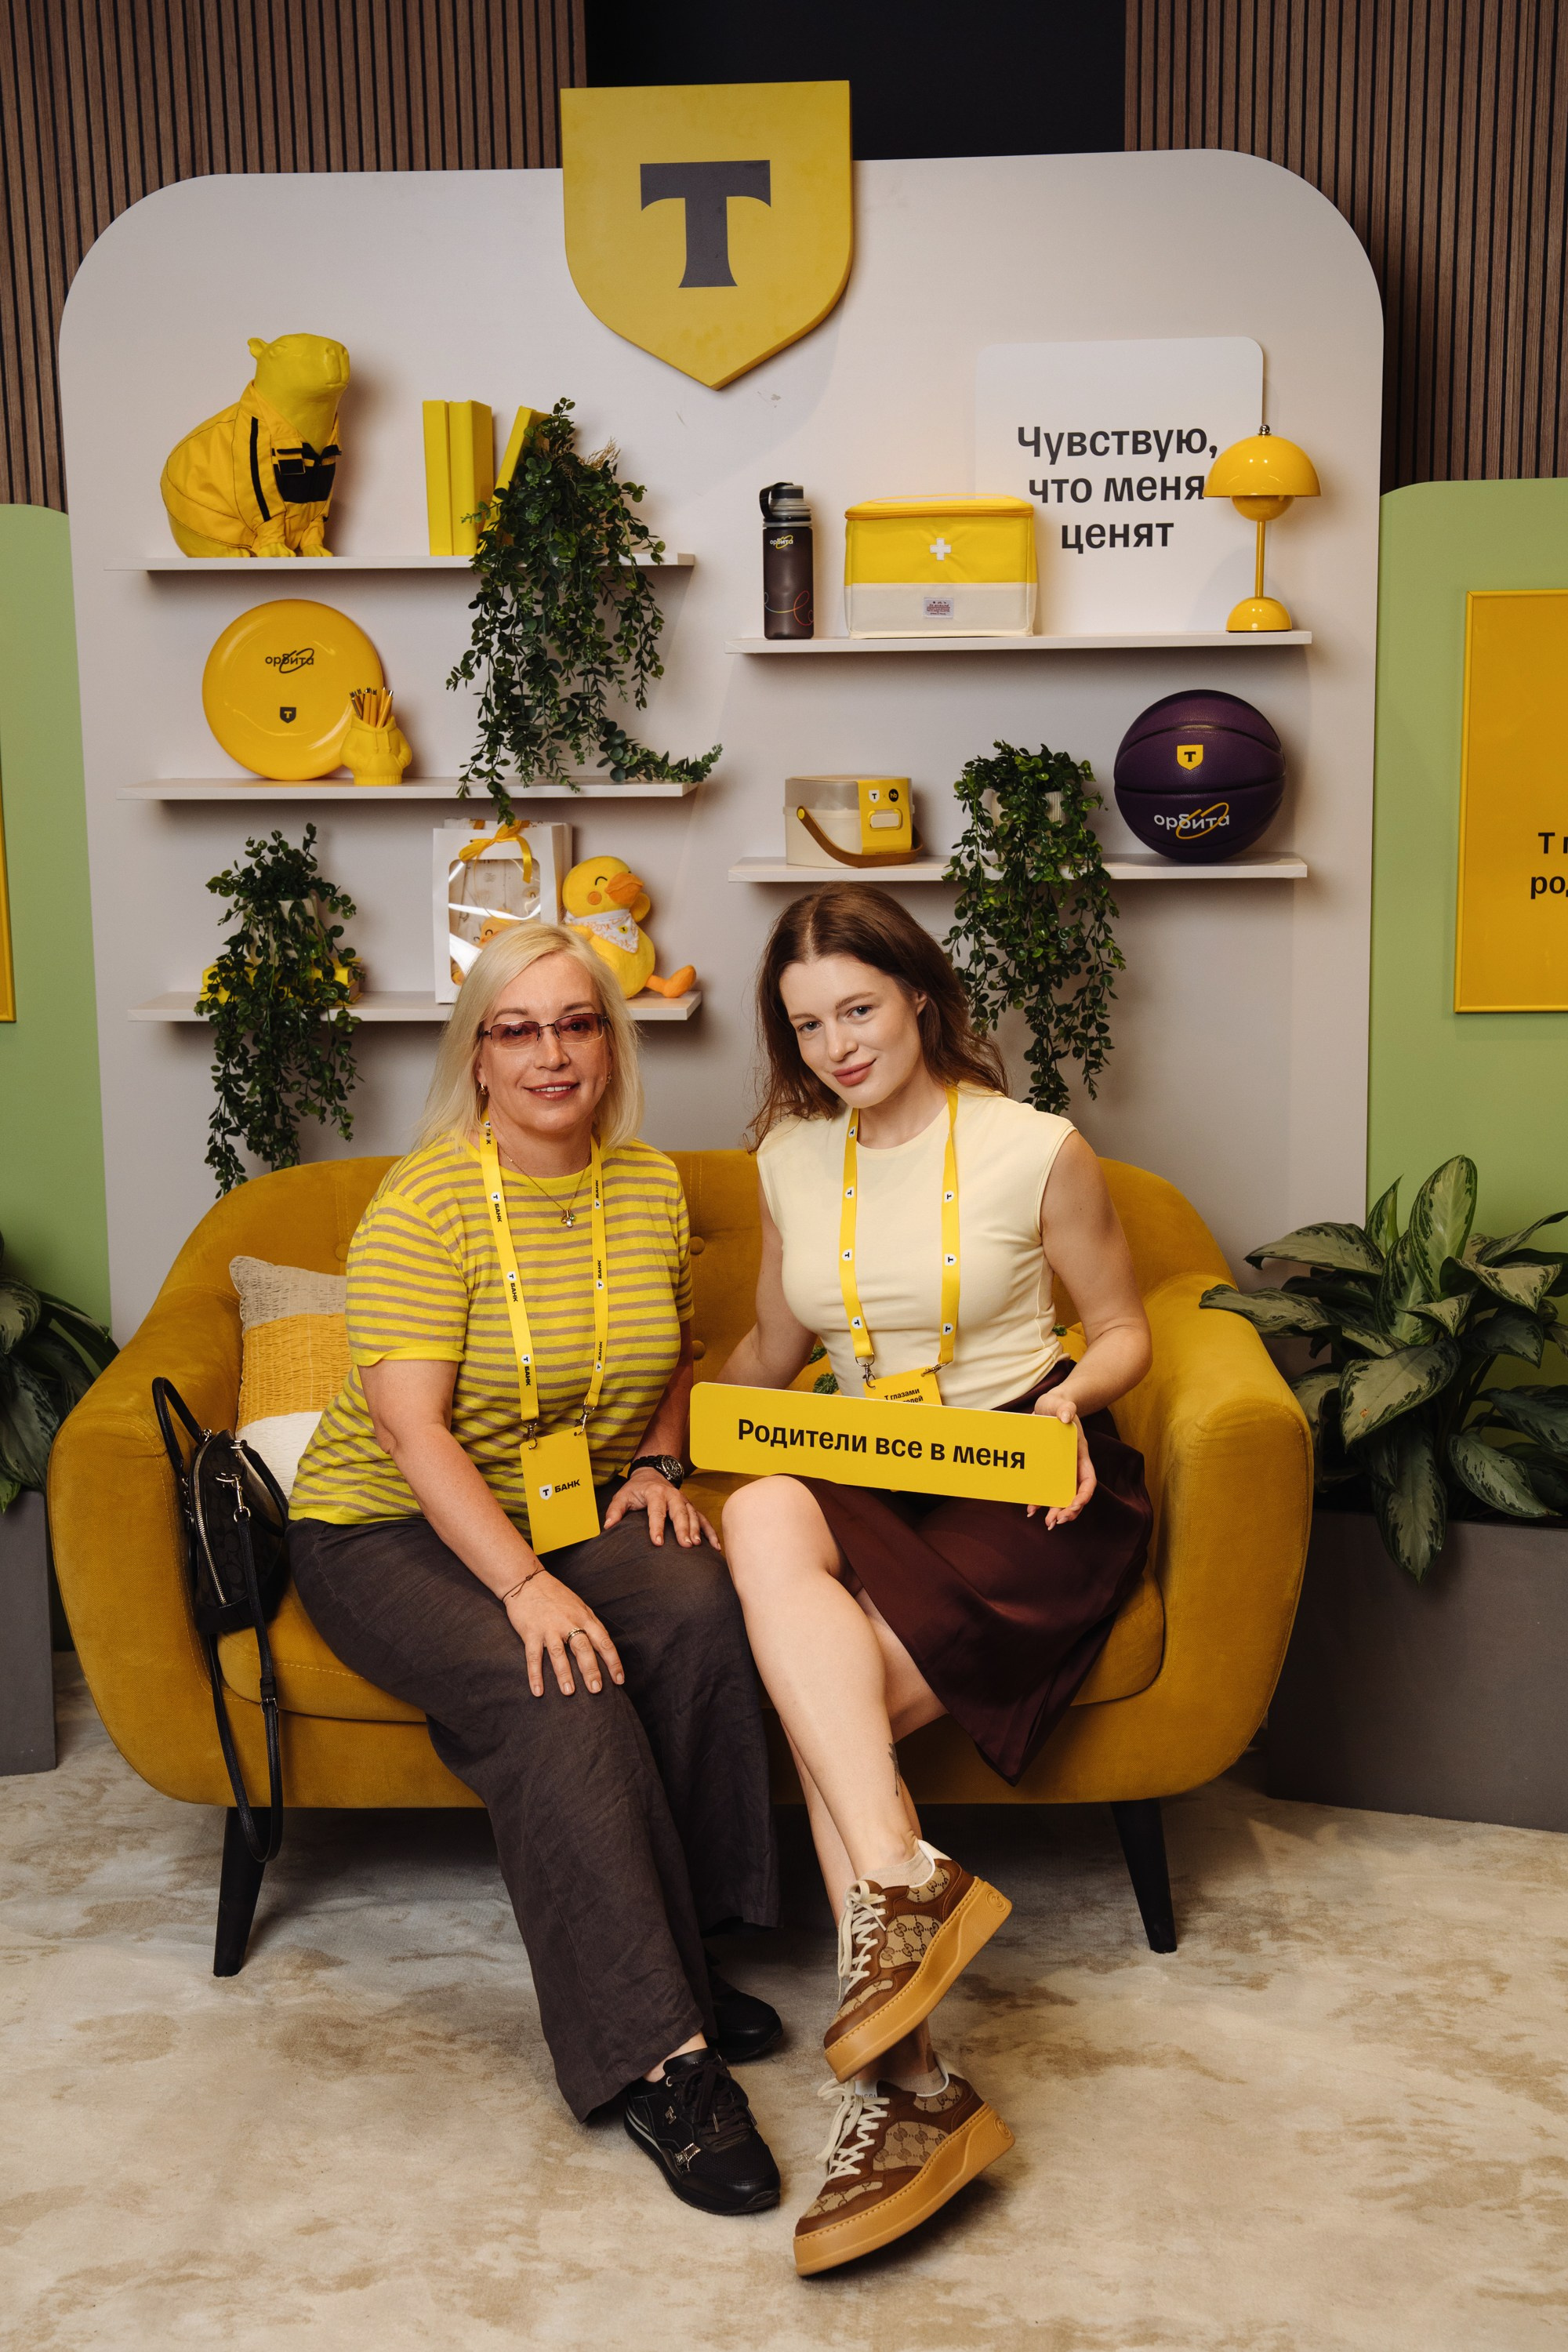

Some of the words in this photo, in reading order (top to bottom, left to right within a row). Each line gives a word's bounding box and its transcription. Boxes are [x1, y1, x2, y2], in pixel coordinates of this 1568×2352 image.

[641, 160, 771, 288] Т
[1018, 426, 1218, 465] Чувствую,
[1029, 478, 1092, 503] что
[1104, 476, 1204, 502] меня
[1062, 523, 1174, 554] ценят
[265, 652, 314, 669] орбита
[1184, 751, 1196, 763] Т
[1154, 811, 1229, 833] орбита
[1538, 832, 1555, 855] Т
[1530, 876, 1568, 899] ро
[890, 1388, 920, 1401] глазами
[738, 1418, 867, 1454] Родители
[876, 1437, 923, 1459] все
[931, 1443, 946, 1461] в
[953, 1445, 1025, 1469] меня
[554, 1479, 580, 1493] БАНК
